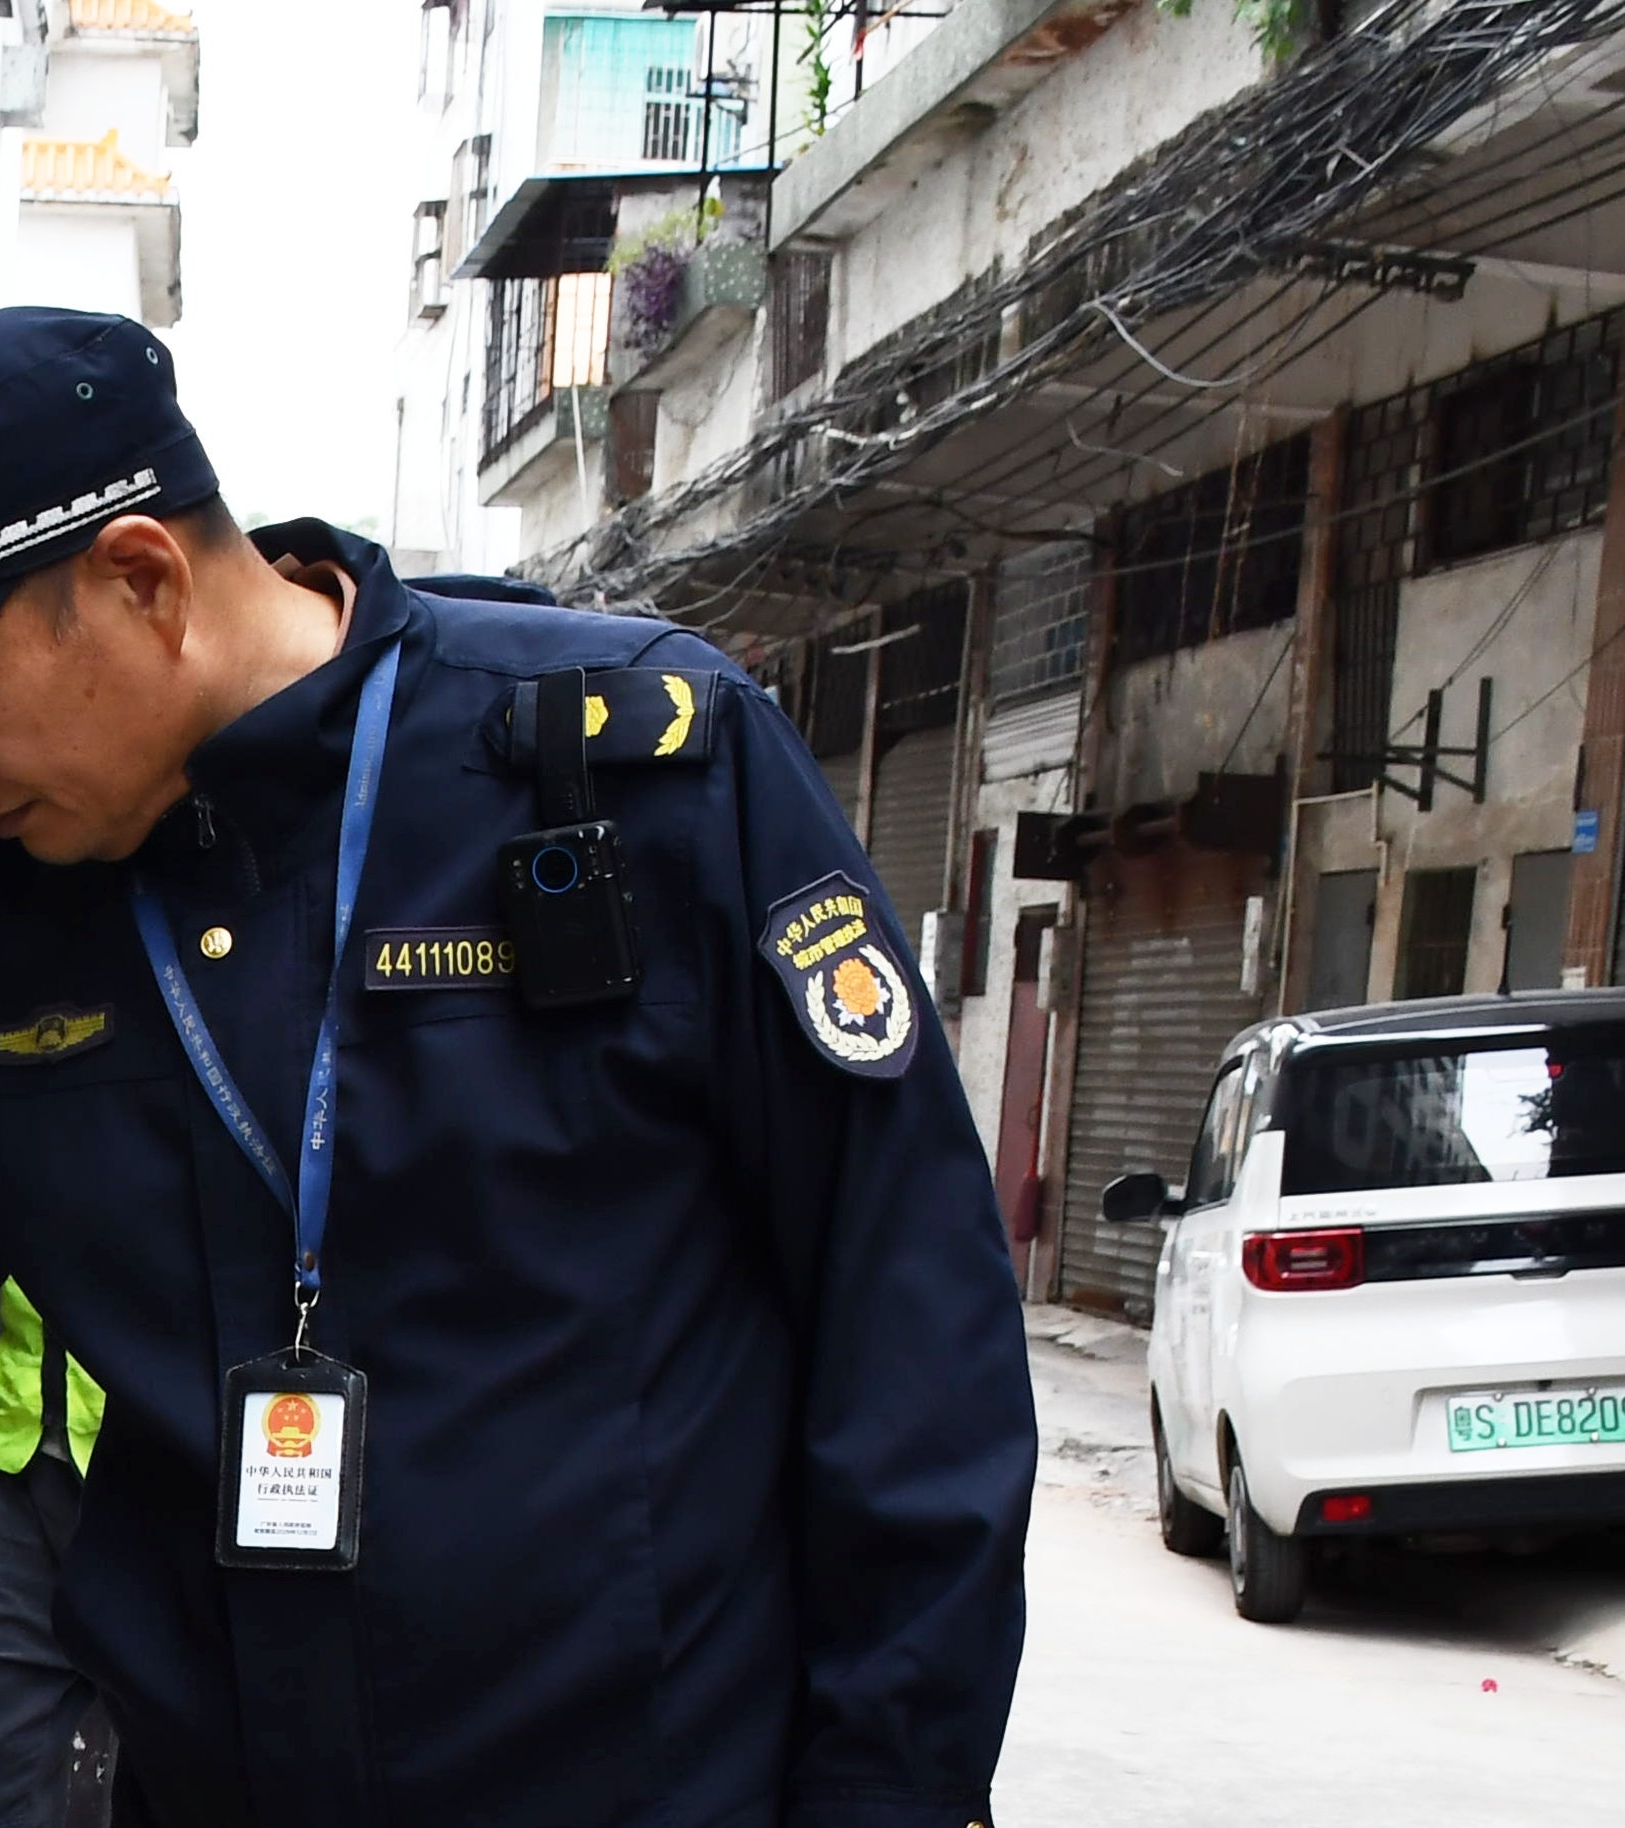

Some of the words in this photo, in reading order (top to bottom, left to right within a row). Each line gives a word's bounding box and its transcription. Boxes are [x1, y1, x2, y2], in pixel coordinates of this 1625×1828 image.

[776, 895, 864, 957] 中华人民共和国
[376, 940, 515, 978] 44111089
[246, 1465, 333, 1479] 中华人民共和国
[257, 1483, 318, 1496] 行政执法证
